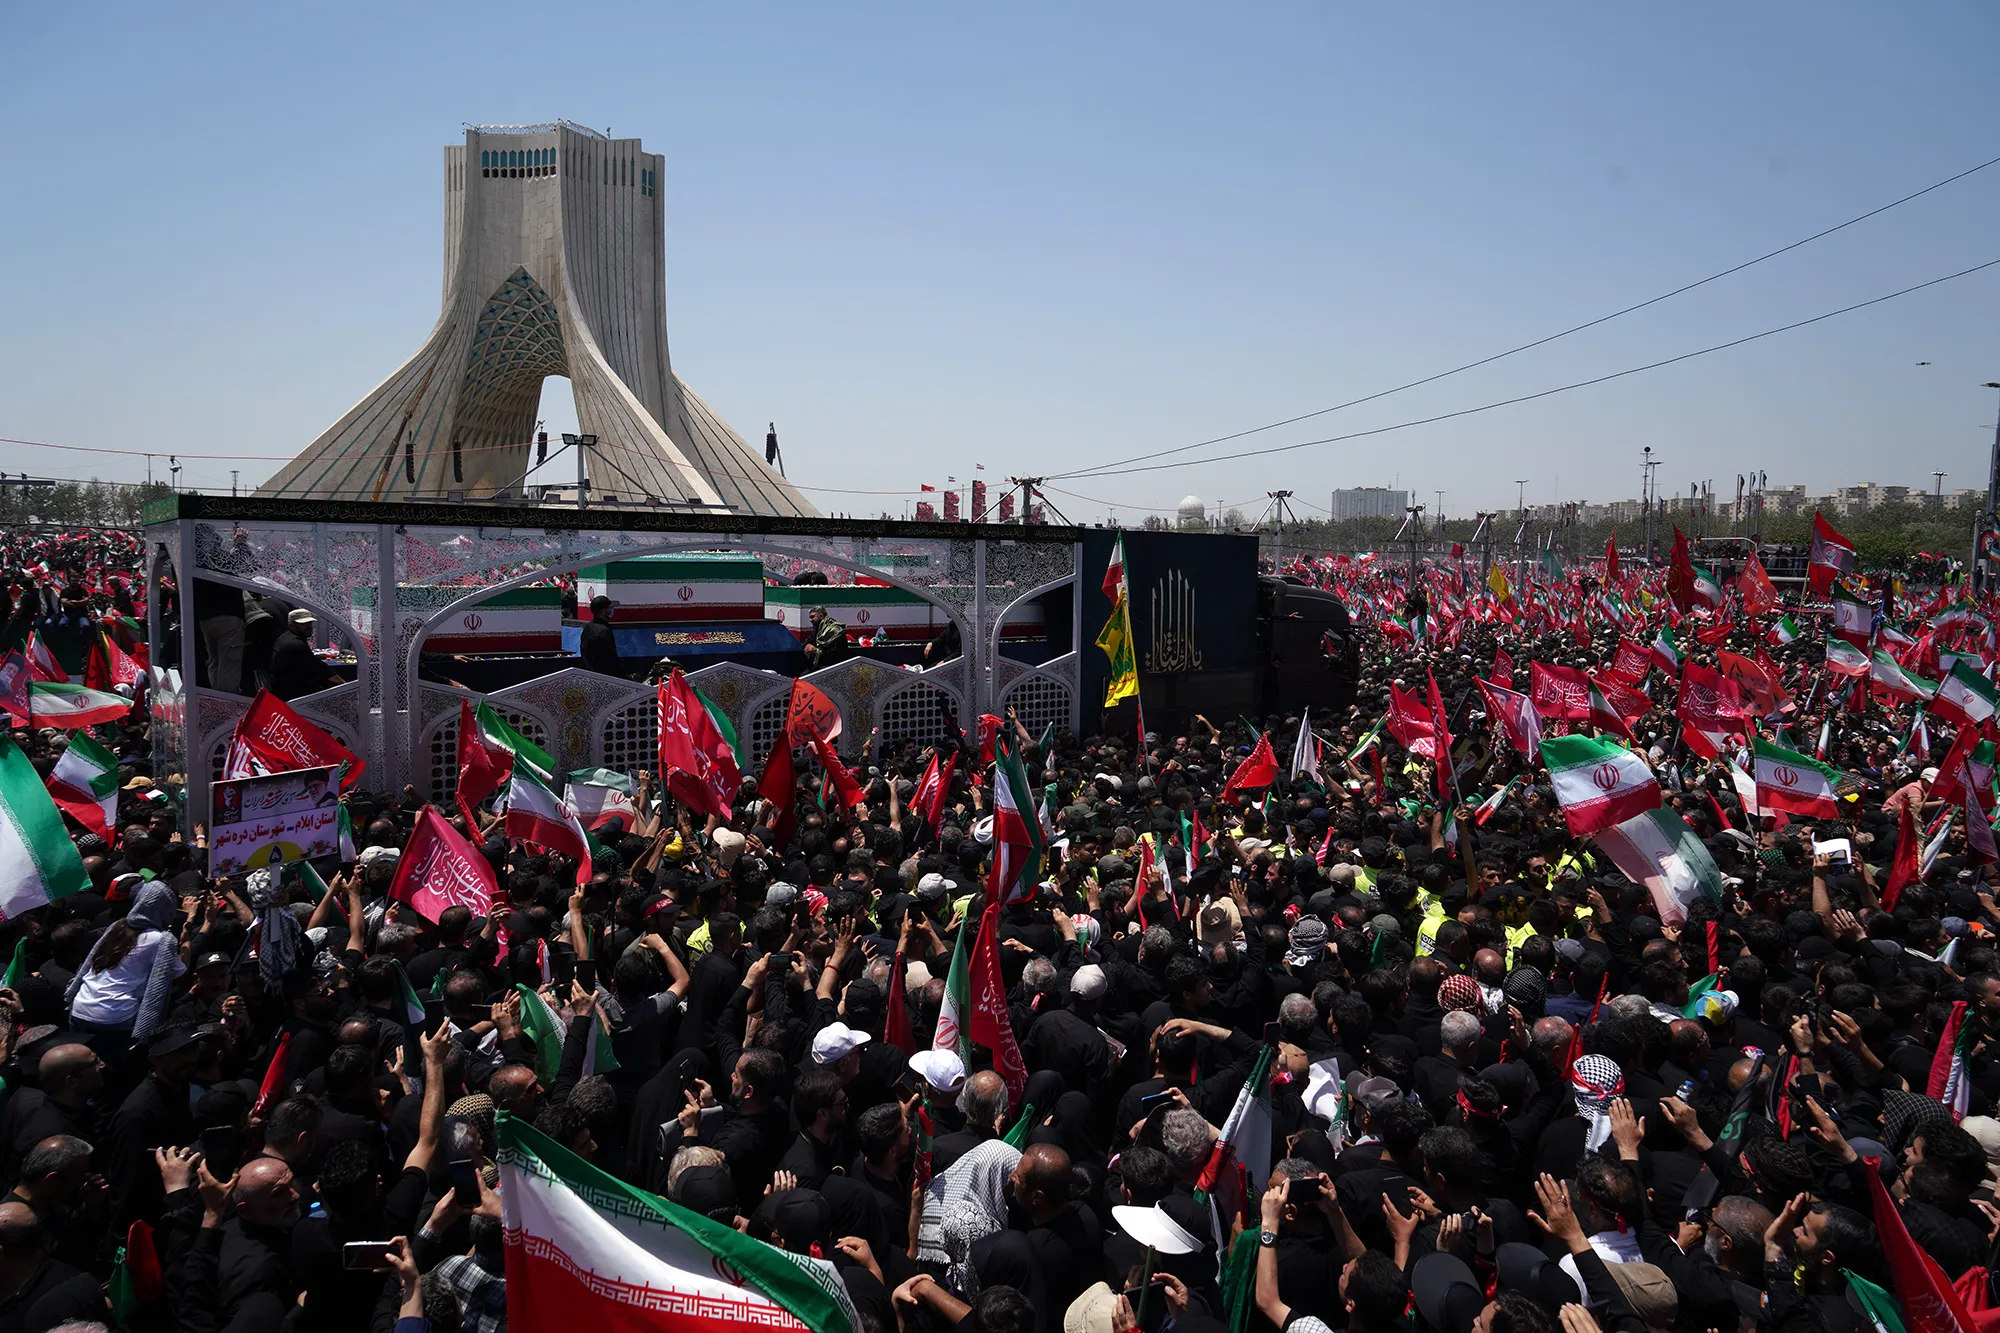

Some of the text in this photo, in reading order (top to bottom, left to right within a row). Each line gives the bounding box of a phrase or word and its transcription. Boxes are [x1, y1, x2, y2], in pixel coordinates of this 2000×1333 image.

[295, 814, 315, 834] ایلام
[314, 810, 337, 830] استان
[214, 830, 232, 850] شهر
[232, 829, 249, 846] دره
[248, 820, 286, 843] شهرستان
[268, 844, 283, 864] ۵
